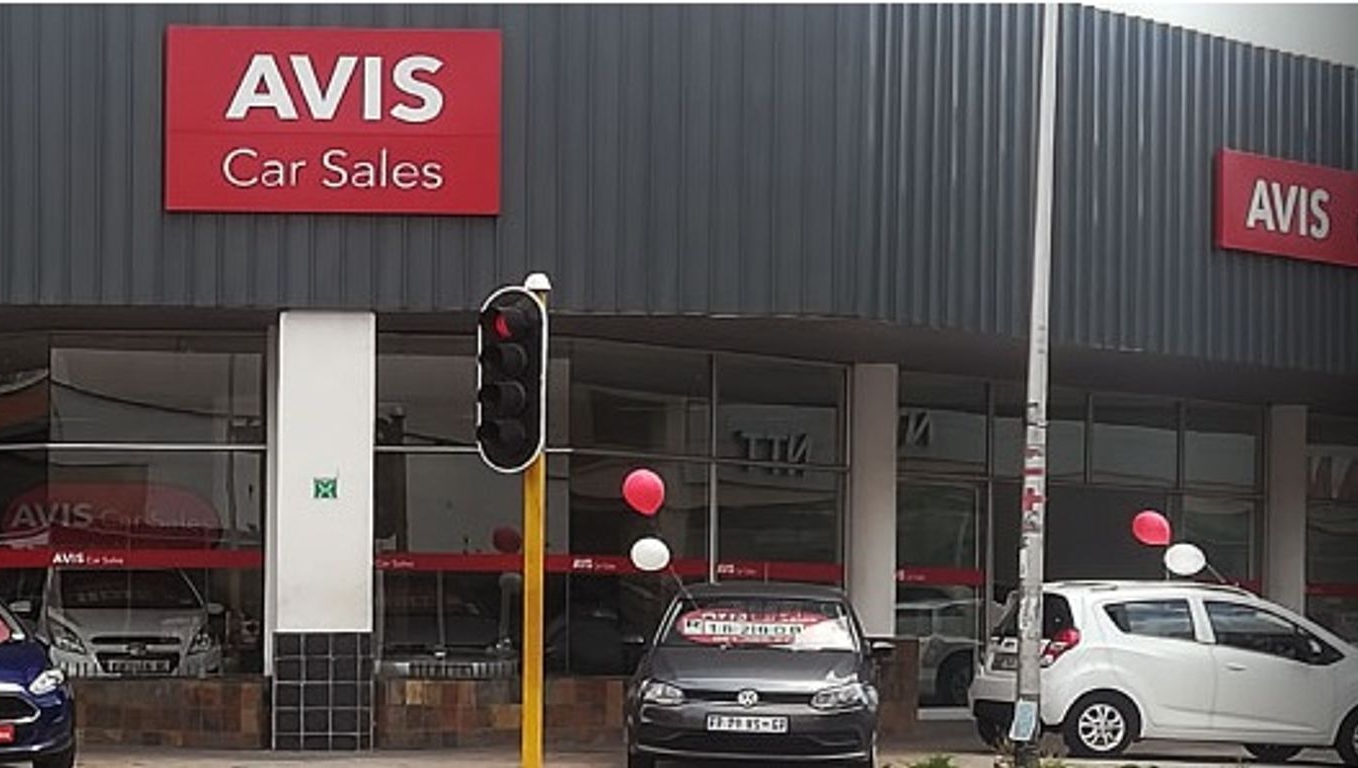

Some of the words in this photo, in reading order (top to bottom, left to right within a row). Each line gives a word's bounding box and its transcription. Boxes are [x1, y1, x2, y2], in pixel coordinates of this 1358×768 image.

[225, 54, 444, 123] AVIS
[222, 148, 307, 188] Car
[322, 148, 443, 189] Sales
[1246, 179, 1331, 240] AVIS
[11, 503, 93, 528] AVIS
[52, 552, 84, 564] AVIS
